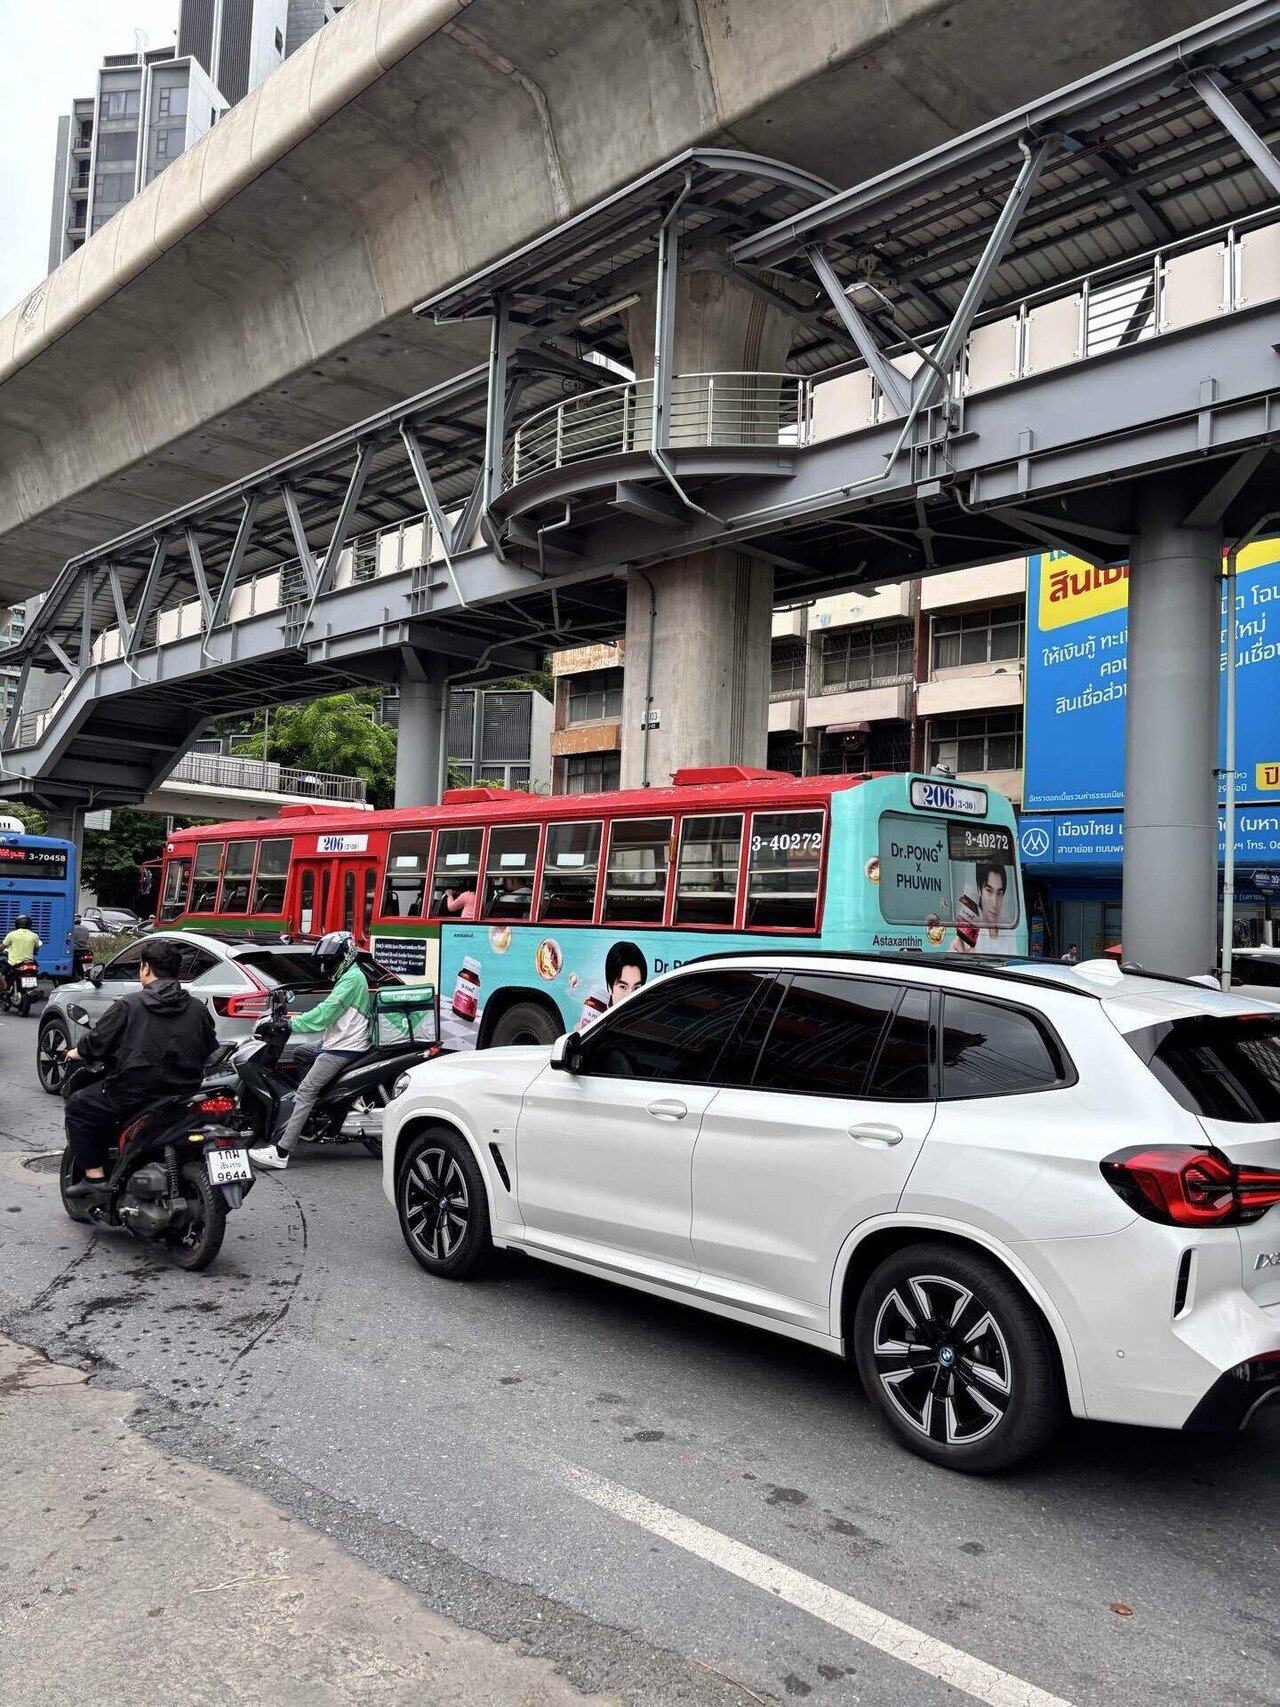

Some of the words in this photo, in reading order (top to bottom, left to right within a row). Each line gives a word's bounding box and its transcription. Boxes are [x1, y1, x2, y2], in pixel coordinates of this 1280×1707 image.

[1042, 635, 1096, 667] ให้เงินกู้
[923, 784, 955, 808] 206
[1058, 820, 1114, 837] เมืองไทย
[323, 836, 344, 851] 206
[751, 832, 822, 852] 3-40272
[965, 830, 1009, 850] 3-40272
[29, 852, 66, 862] 3-70458
[1057, 844, 1094, 854] สาขาย่อย
[896, 873, 942, 892] PHUWIN
[872, 935, 923, 948] Astaxanthin
[217, 1170, 247, 1181] 9644
